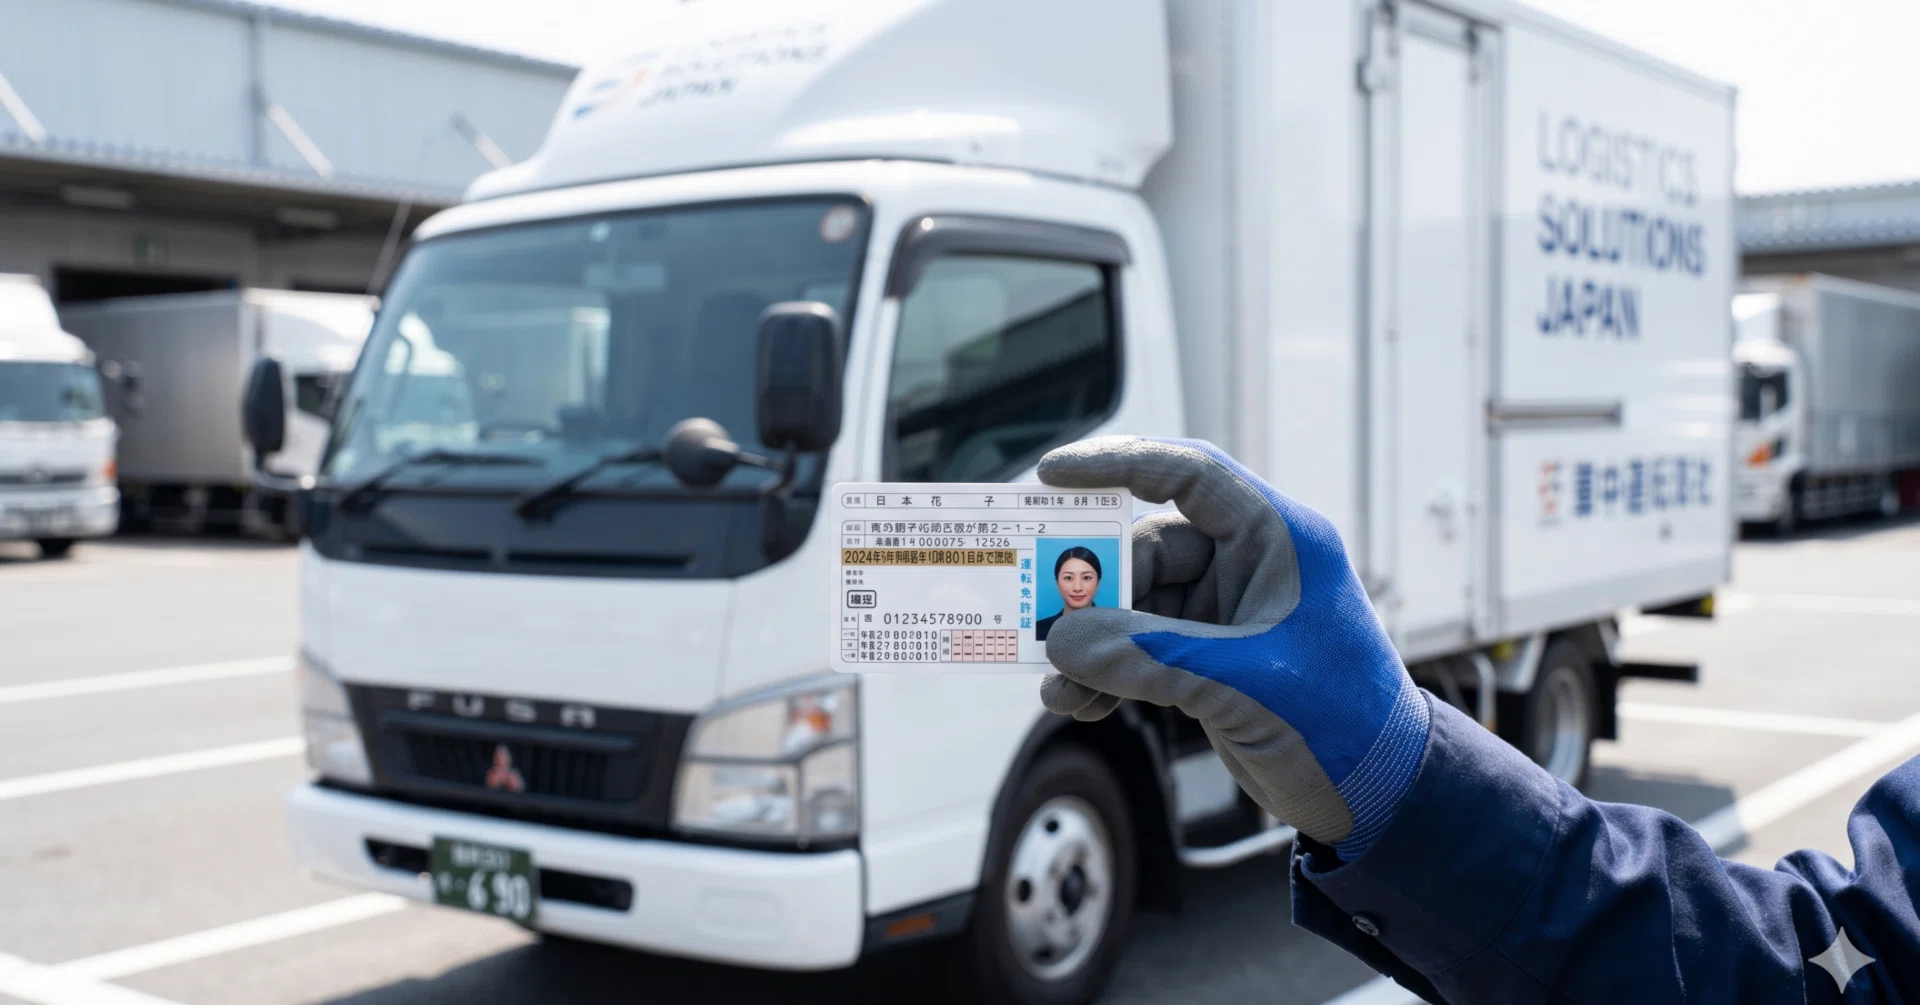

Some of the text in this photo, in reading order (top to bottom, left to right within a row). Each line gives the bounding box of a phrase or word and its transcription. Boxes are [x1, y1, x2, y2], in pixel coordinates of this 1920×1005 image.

[1538, 110, 1697, 206] LOGISTICS
[1537, 194, 1707, 277] SOLUTIONS
[1537, 274, 1642, 340] JAPAN
[883, 613, 982, 625] 01234578900
[1020, 558, 1032, 628] 運転免許証
